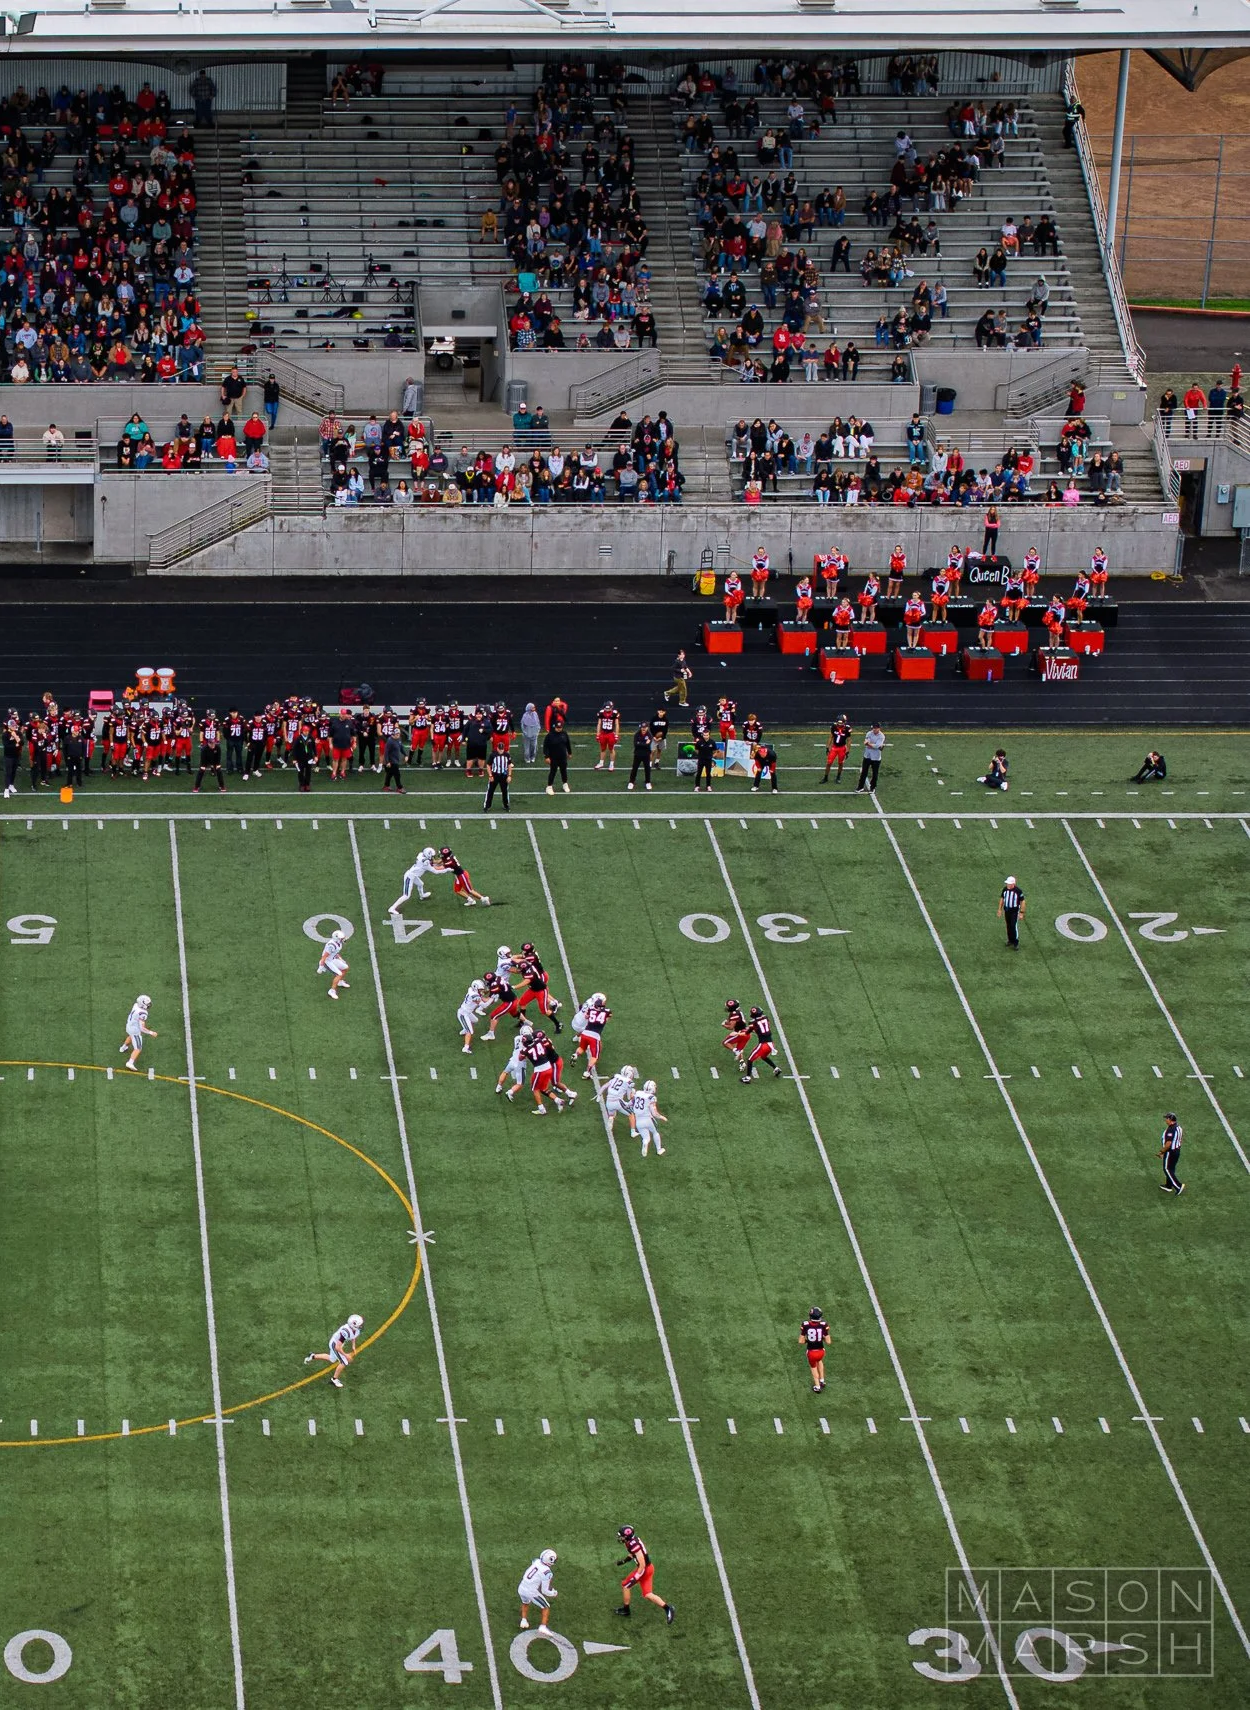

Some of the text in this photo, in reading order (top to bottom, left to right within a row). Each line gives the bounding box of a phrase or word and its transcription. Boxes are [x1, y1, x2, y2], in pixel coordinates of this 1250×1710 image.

[1175, 461, 1188, 469] AED
[1163, 514, 1178, 523] AED
[969, 565, 1010, 586] Queen B
[1045, 659, 1078, 680] Vivian
[434, 724, 446, 733] 34
[495, 721, 507, 731] 77
[588, 1010, 607, 1025] 54
[757, 1018, 770, 1033] 17
[528, 1043, 546, 1061] 74
[611, 1078, 624, 1091] 12
[635, 1096, 646, 1110] 33
[807, 1328, 822, 1342] 81
[527, 1567, 538, 1580] 0
[403, 1627, 578, 1684] 40
[907, 1626, 1087, 1682] 30
